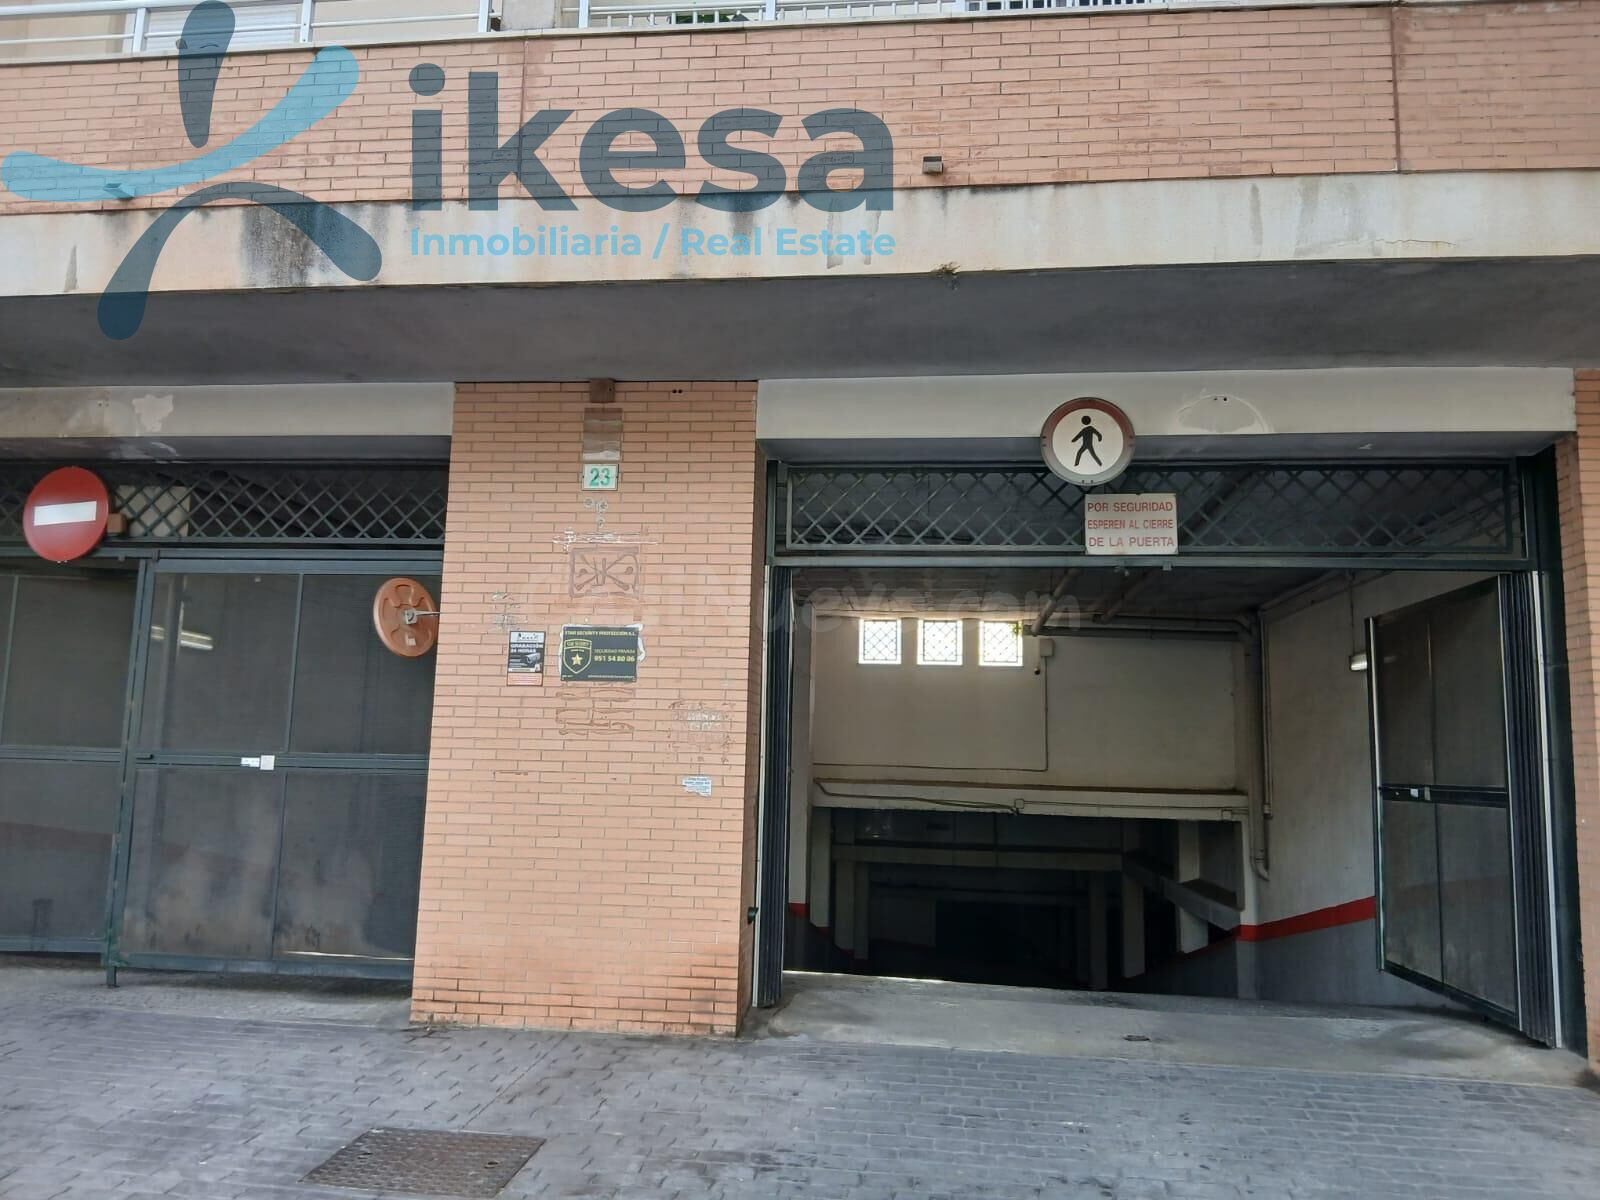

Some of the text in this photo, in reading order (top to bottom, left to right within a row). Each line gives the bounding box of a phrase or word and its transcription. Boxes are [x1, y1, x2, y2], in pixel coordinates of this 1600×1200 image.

[590, 467, 610, 486] 23
[1087, 501, 1173, 512] POR SEGURIDAD
[1087, 519, 1174, 530] ESPEREN AL CIERRE
[1089, 536, 1175, 547] DE LA PUERTA
